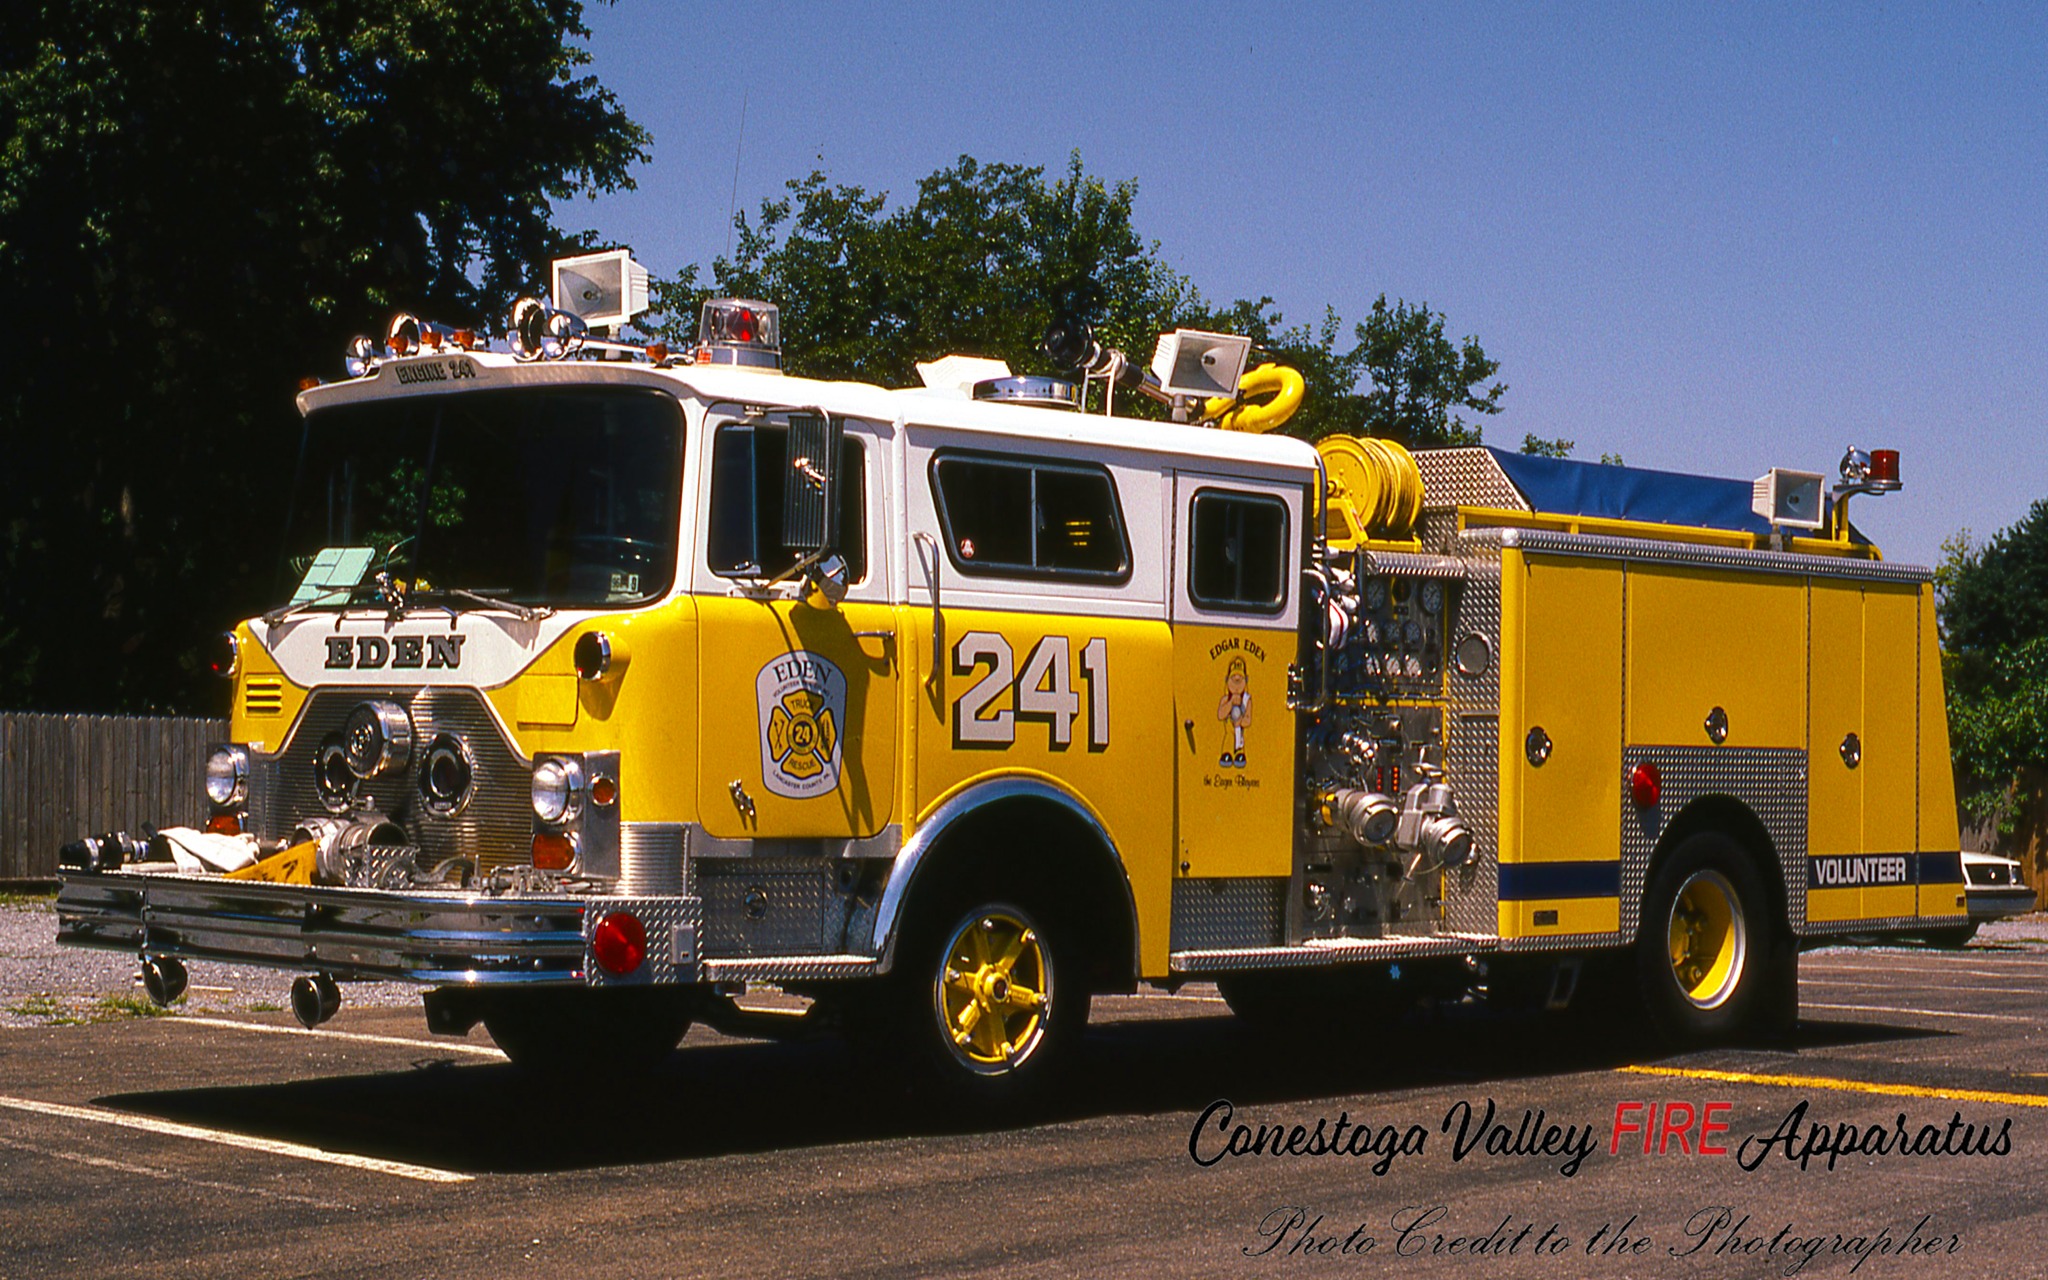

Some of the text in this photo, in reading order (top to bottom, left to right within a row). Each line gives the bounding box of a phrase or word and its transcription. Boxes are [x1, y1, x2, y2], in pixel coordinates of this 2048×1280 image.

[395, 359, 476, 384] ENGINE 241
[324, 634, 466, 670] EDEN
[1209, 637, 1267, 663] EDGAR EDEN
[772, 660, 832, 684] EDEN
[951, 629, 1110, 754] 241
[795, 725, 810, 743] 24
[789, 758, 816, 770] RESCUE
[1815, 856, 1906, 885] VOLUNTEER
